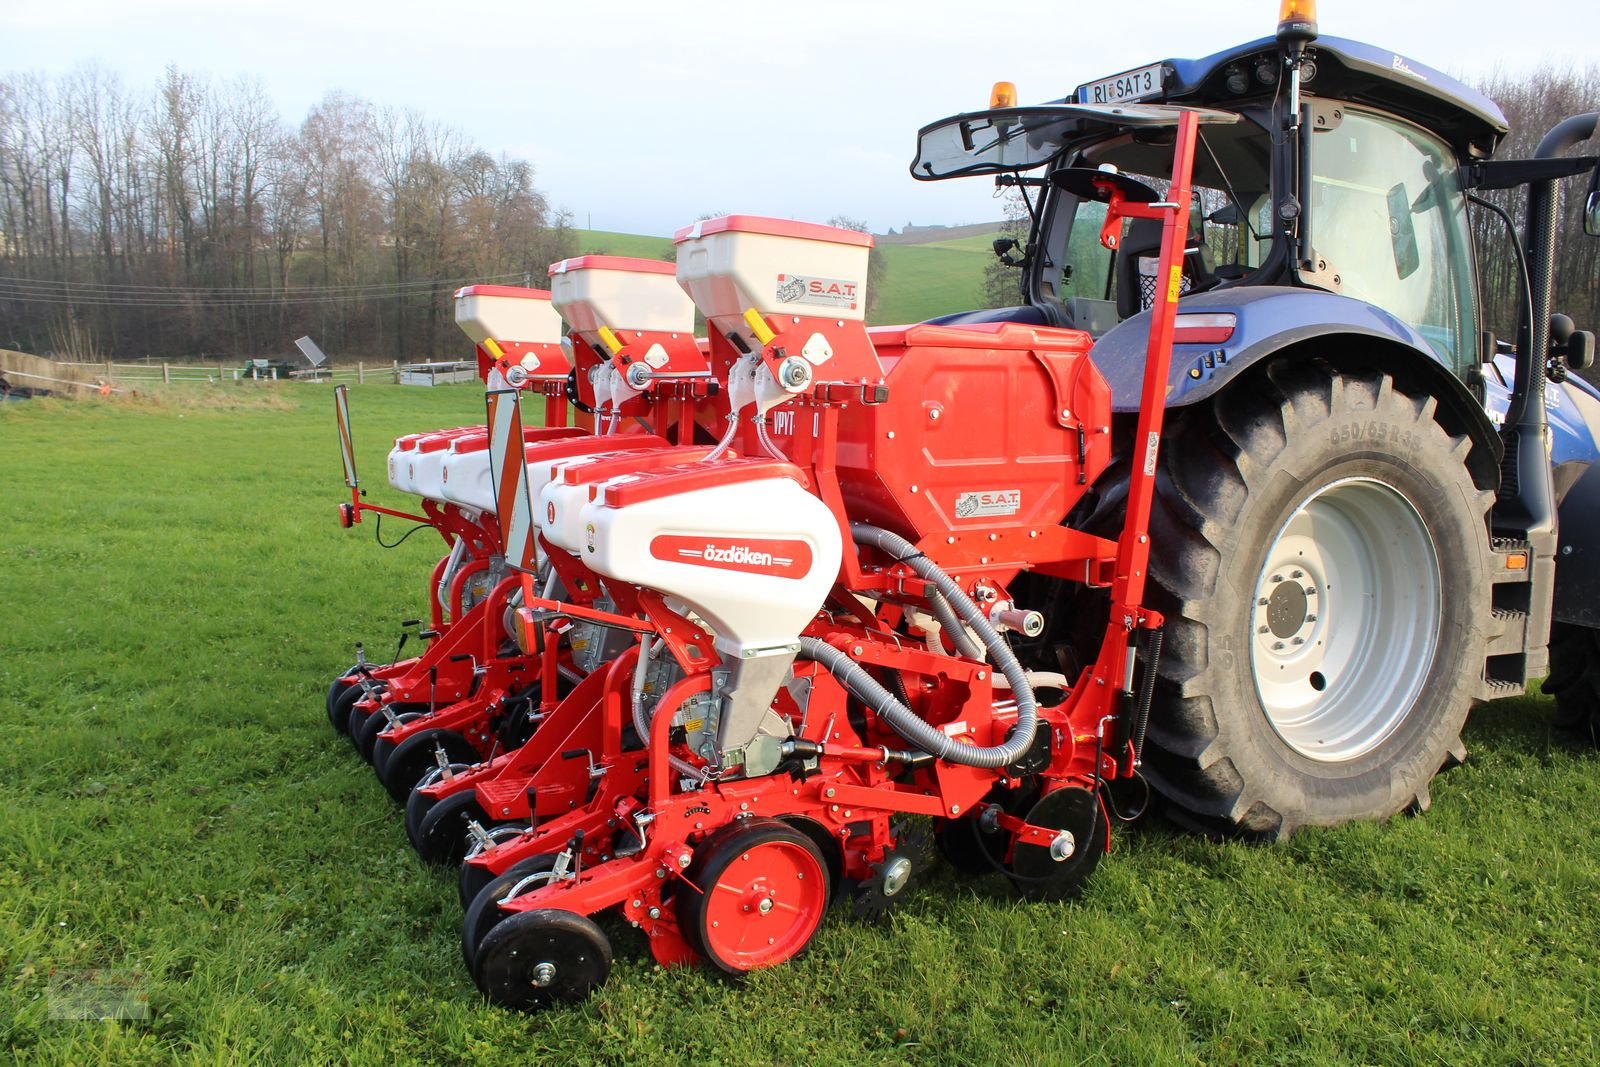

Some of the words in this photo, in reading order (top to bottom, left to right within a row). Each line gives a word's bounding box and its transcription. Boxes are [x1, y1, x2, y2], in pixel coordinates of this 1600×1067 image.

[1094, 84, 1107, 104] RI
[1116, 74, 1140, 98] SAT
[1144, 71, 1151, 91] 3
[809, 281, 856, 297] S.A.T.
[1330, 421, 1387, 445] 650/65
[981, 493, 1019, 506] S.A.T.
[703, 544, 772, 566] özdöken
